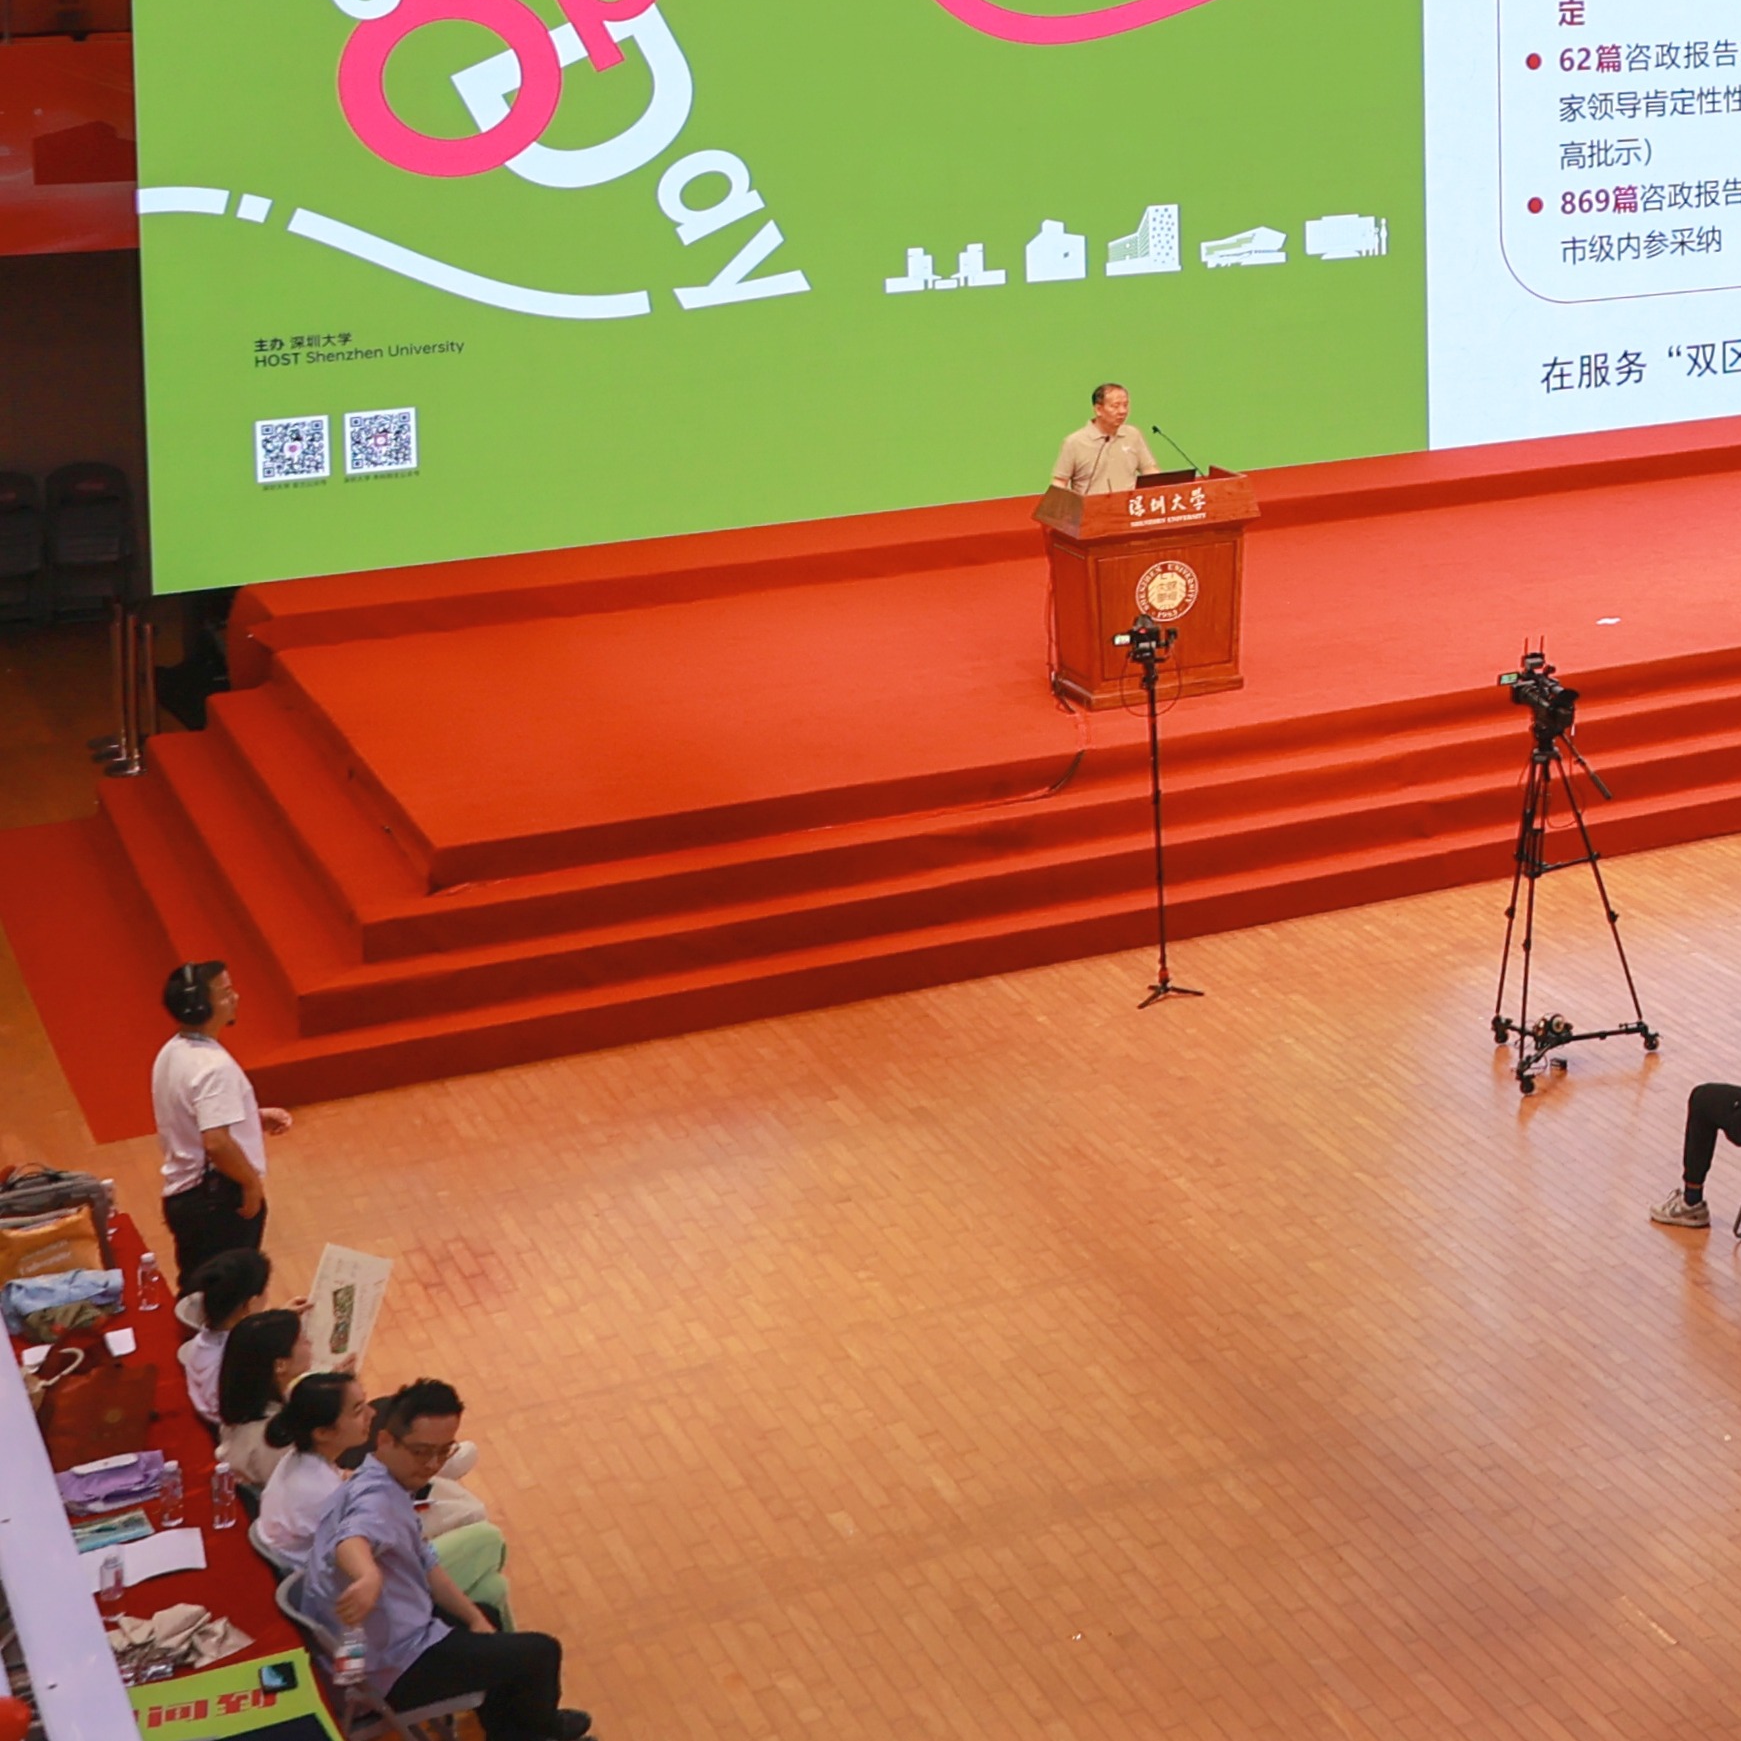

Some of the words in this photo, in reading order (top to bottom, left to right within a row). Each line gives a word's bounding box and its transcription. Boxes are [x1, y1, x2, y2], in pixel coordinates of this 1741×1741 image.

[1557, 0, 1587, 27] 定
[1560, 227, 1724, 266] 市级内参采纳
[254, 337, 285, 353] 主办
[290, 331, 352, 349] 深圳大学
[254, 351, 301, 368] HOST
[306, 346, 384, 364] Shenzhen
[388, 340, 465, 358] University
